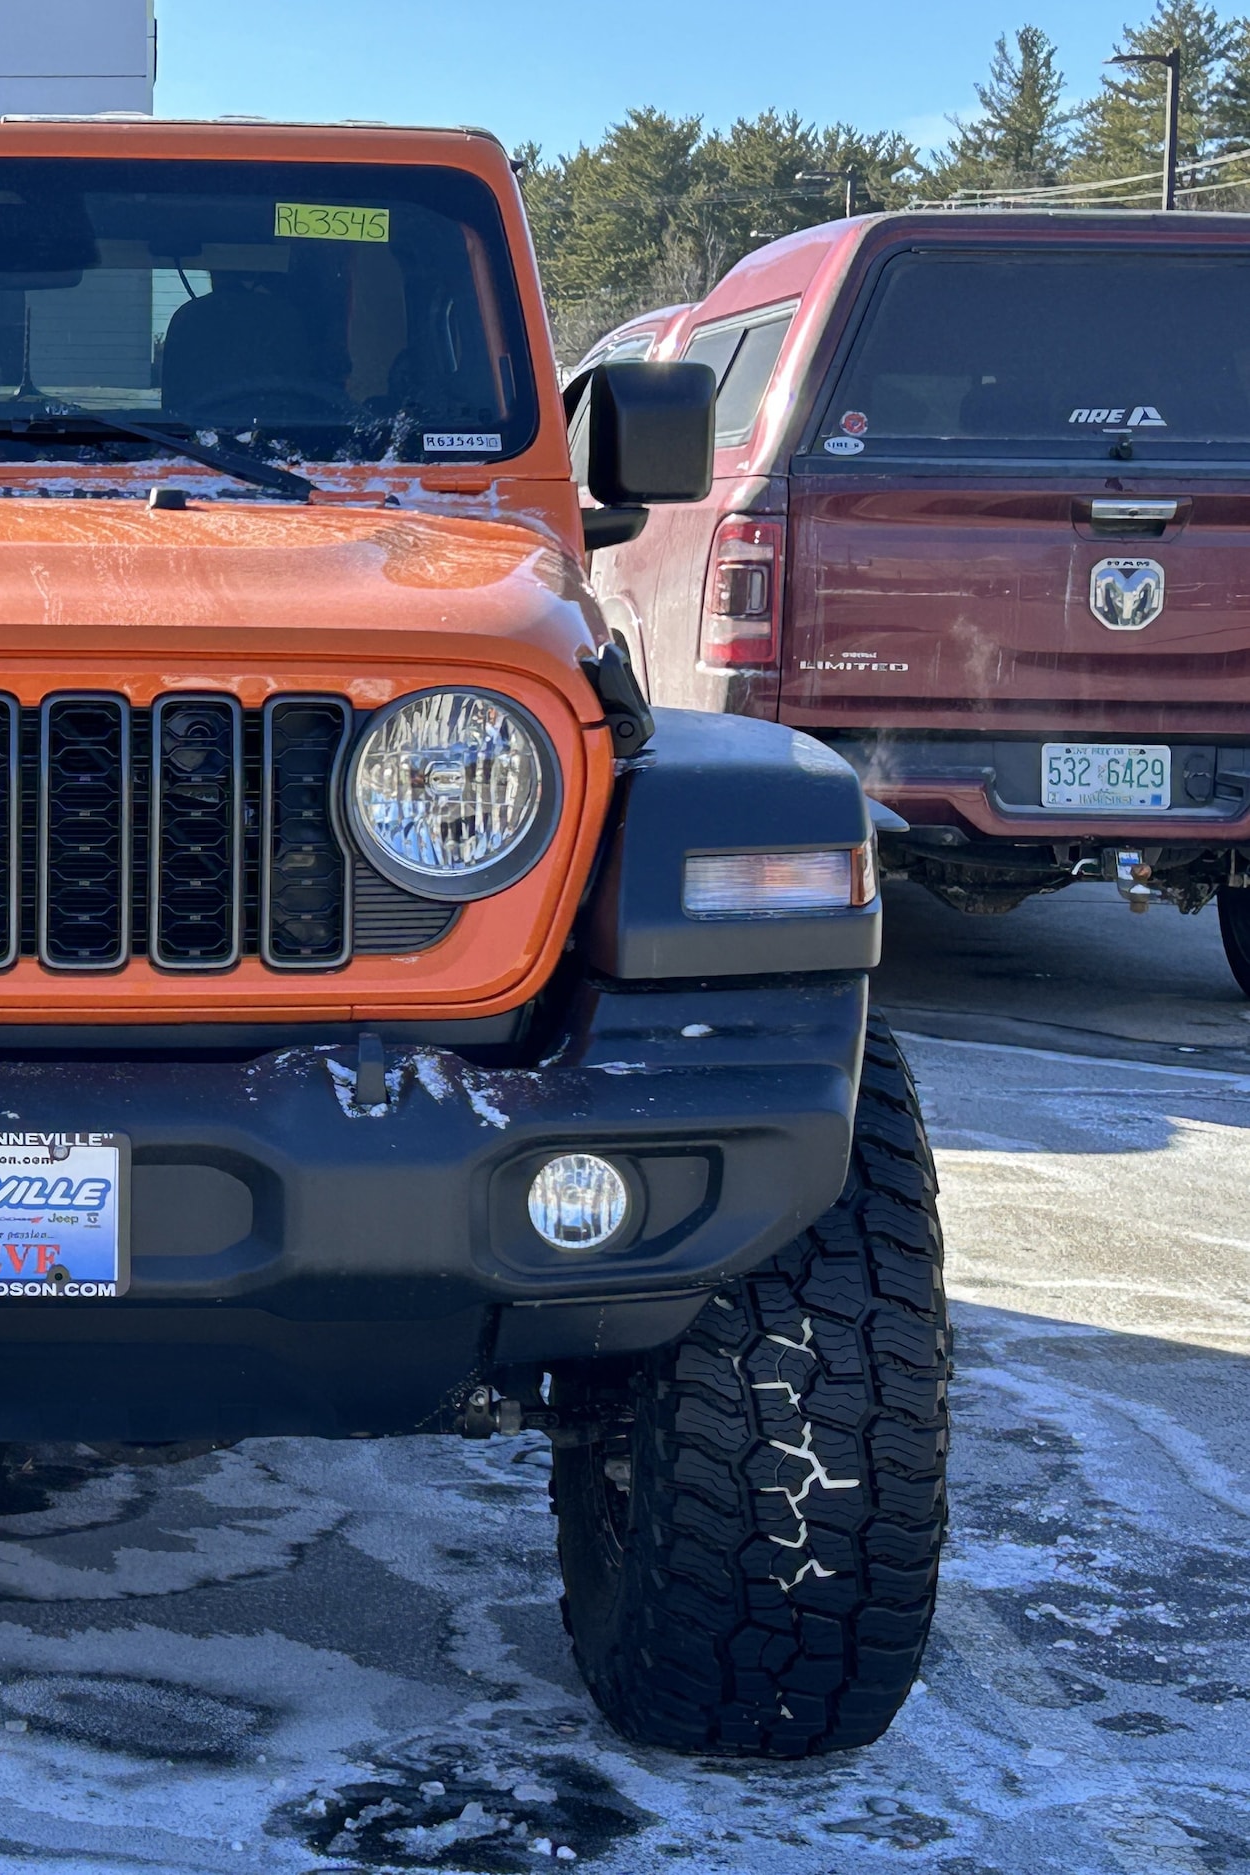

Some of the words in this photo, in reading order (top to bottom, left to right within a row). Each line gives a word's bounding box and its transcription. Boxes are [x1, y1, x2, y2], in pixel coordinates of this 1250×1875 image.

[276, 206, 387, 240] R63545
[1068, 408, 1126, 423] ARE
[799, 660, 909, 671] LIMITED
[1048, 756, 1092, 787] 532
[1107, 758, 1165, 788] 6429
[48, 1213, 79, 1224] Jeep
